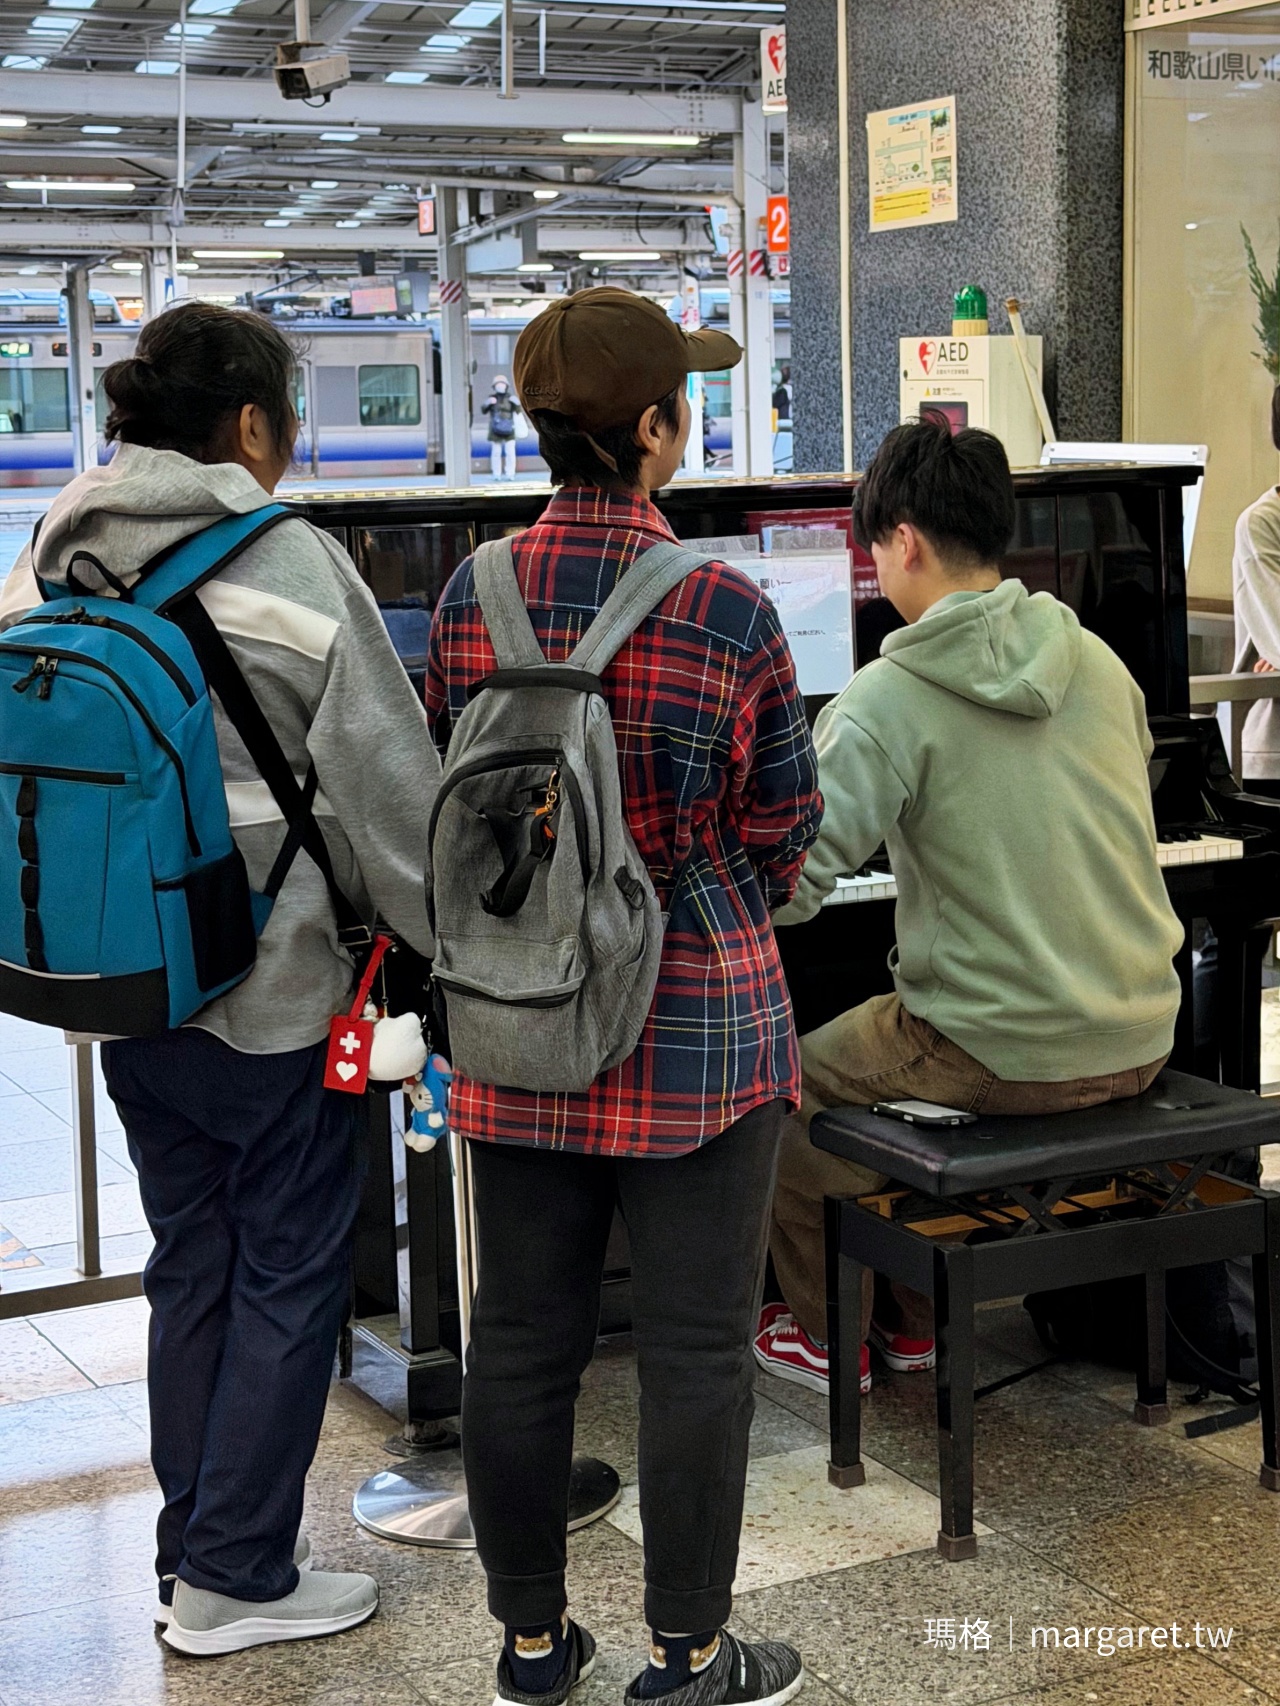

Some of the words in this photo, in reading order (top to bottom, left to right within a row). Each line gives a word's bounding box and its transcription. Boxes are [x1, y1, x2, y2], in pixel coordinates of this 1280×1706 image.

[767, 79, 783, 98] AE
[422, 204, 430, 230] 3
[770, 205, 786, 244] 2
[938, 342, 969, 362] AED
